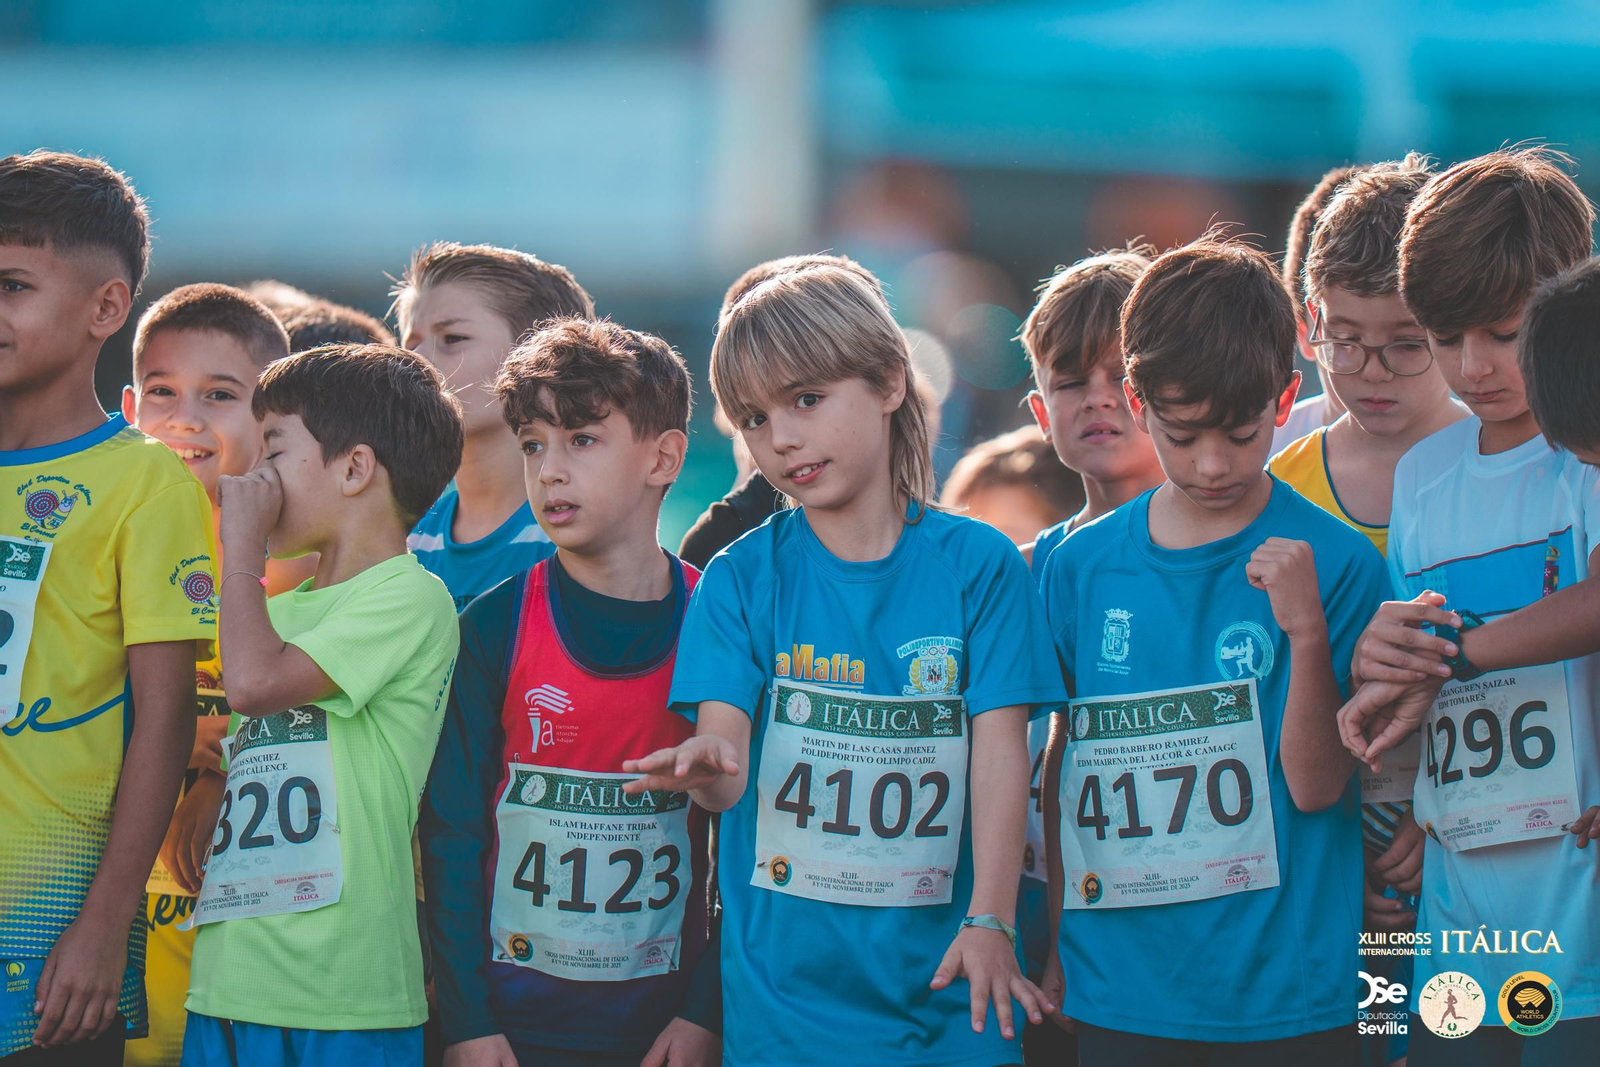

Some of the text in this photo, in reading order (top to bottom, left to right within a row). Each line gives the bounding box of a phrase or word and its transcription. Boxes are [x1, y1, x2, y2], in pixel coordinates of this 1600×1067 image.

[3, 567, 27, 578] Sevilla
[776, 643, 865, 684] aMafia
[1482, 677, 1516, 690] SAIZAR
[1449, 693, 1486, 707] TOMARES
[822, 702, 921, 731] ITÁLICA
[1098, 701, 1197, 732] ITÁLICA
[1214, 713, 1240, 724] Sevilla
[822, 724, 872, 736] INTERNATIONAL
[932, 727, 953, 735] Sevilla
[1100, 729, 1144, 738] INTERNATIONAL
[1167, 722, 1198, 731] COUNTRY
[289, 733, 314, 741] Sevilla
[802, 735, 937, 755] MARTIN DE LAS CASAS JIMENEZ
[1094, 735, 1210, 756] PEDRO BARBERO RAMIREZ
[1427, 700, 1556, 789] 4296
[801, 746, 936, 765] POLIDEPORTIVO OLIMPO CADIZ
[1077, 759, 1092, 768] EDM
[1093, 757, 1128, 767] MAIRENA
[1129, 755, 1147, 764] DEL
[1149, 750, 1183, 762] ALCOR
[1185, 749, 1192, 758] &
[1194, 742, 1238, 756] CAMAGC
[246, 763, 288, 776] CALLENCE
[555, 780, 657, 808] ITÁLICA
[774, 762, 950, 839] 4102
[1077, 757, 1254, 841] 4170
[554, 803, 604, 814] INTERNATIONAL
[549, 818, 658, 832] ISLAM HAFFANE TRIBAK
[566, 830, 641, 842] INDEPENDIENTE
[512, 841, 681, 914] 4123
[821, 875, 865, 887] INTERNACIONAL
[865, 880, 873, 888] DE
[1128, 878, 1169, 889] INTERNACIONAL
[1169, 877, 1177, 885] DE
[824, 882, 831, 890] DE
[832, 884, 864, 893] NOVIEMBRE
[1139, 885, 1169, 894] NOVIEMBRE
[1179, 882, 1191, 890] 2025
[559, 953, 602, 963] INTERNACIONAL
[570, 961, 601, 969] NOVIEMBRE
